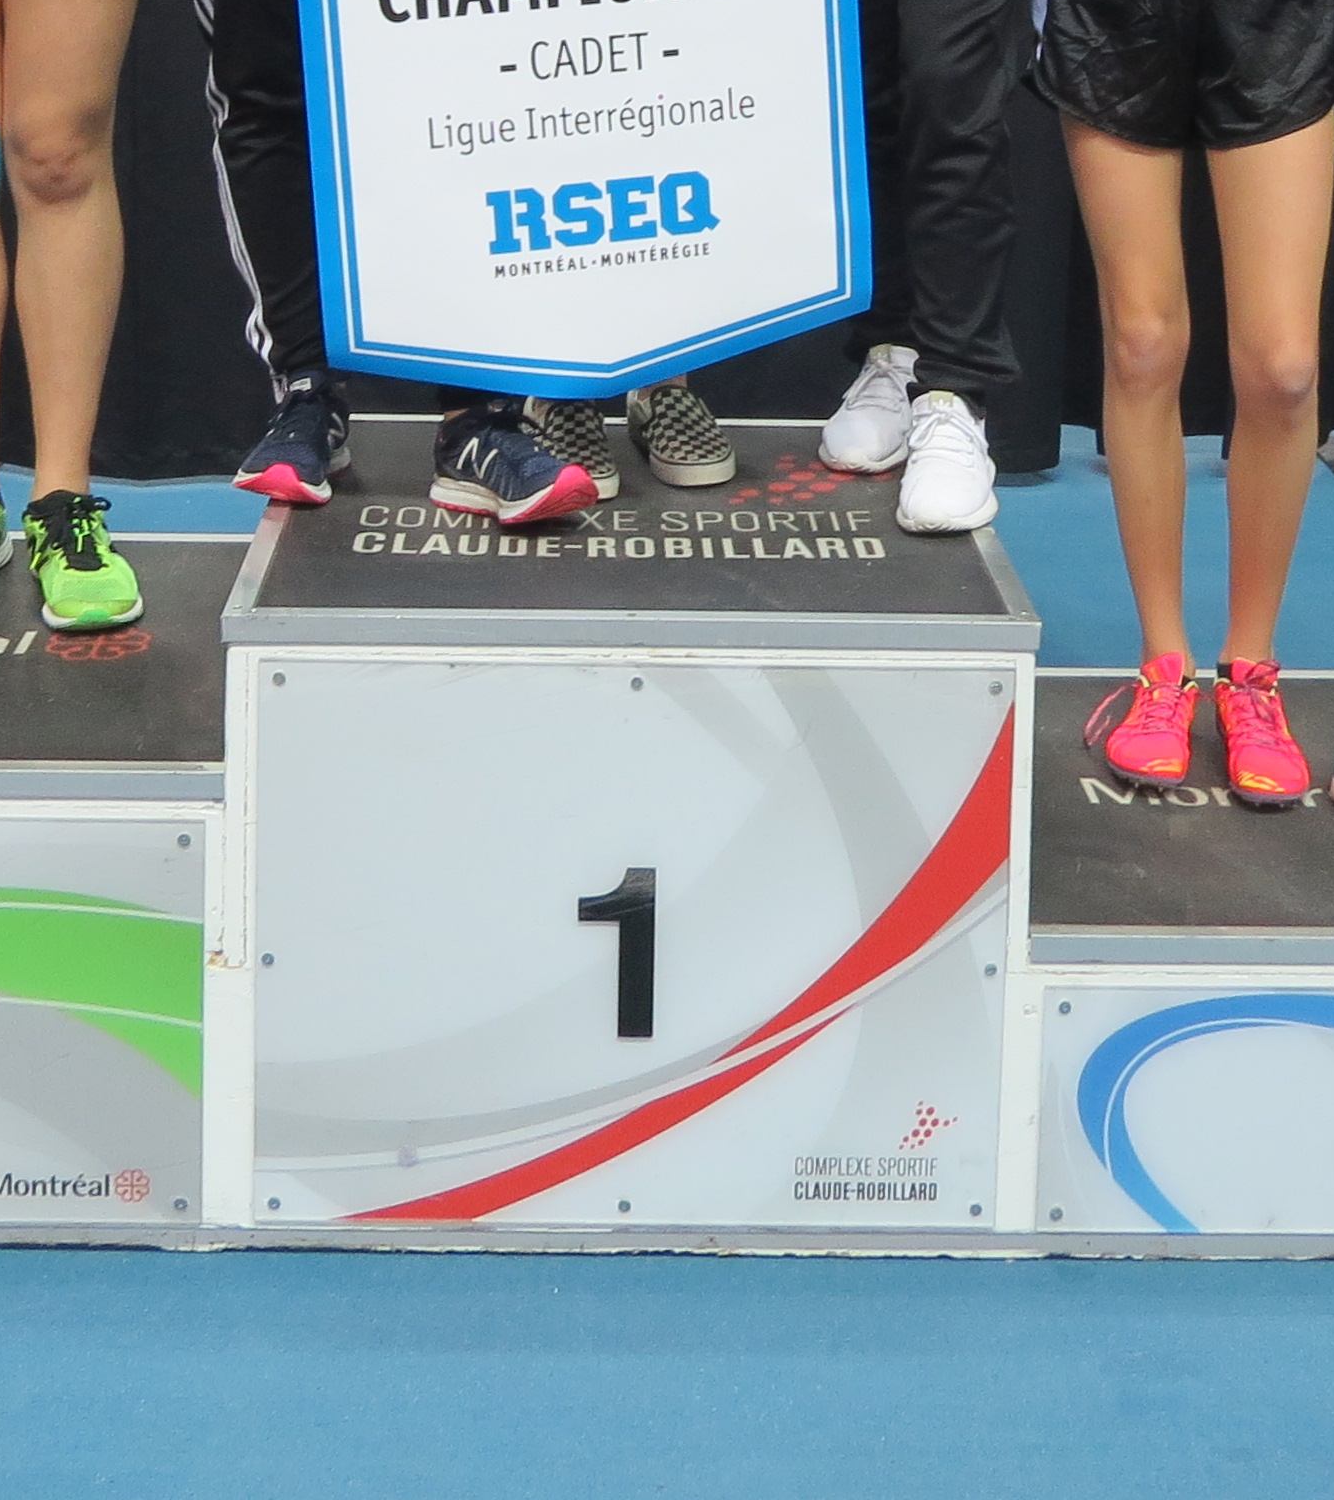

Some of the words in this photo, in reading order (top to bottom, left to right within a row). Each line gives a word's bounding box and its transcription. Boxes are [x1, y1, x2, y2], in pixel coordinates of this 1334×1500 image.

[427, 106, 516, 156] Ligue
[526, 90, 755, 142] Interrégionale
[485, 171, 720, 255] RSEQ
[661, 509, 872, 534] SPORTIF
[352, 532, 886, 561] CLAUDE-ROBILLARD
[577, 867, 657, 1039] 1
[794, 1157, 872, 1176] COMPLEXE
[878, 1157, 938, 1177] SPORTIF
[794, 1181, 938, 1201] CLAUDE-ROBILLARD
